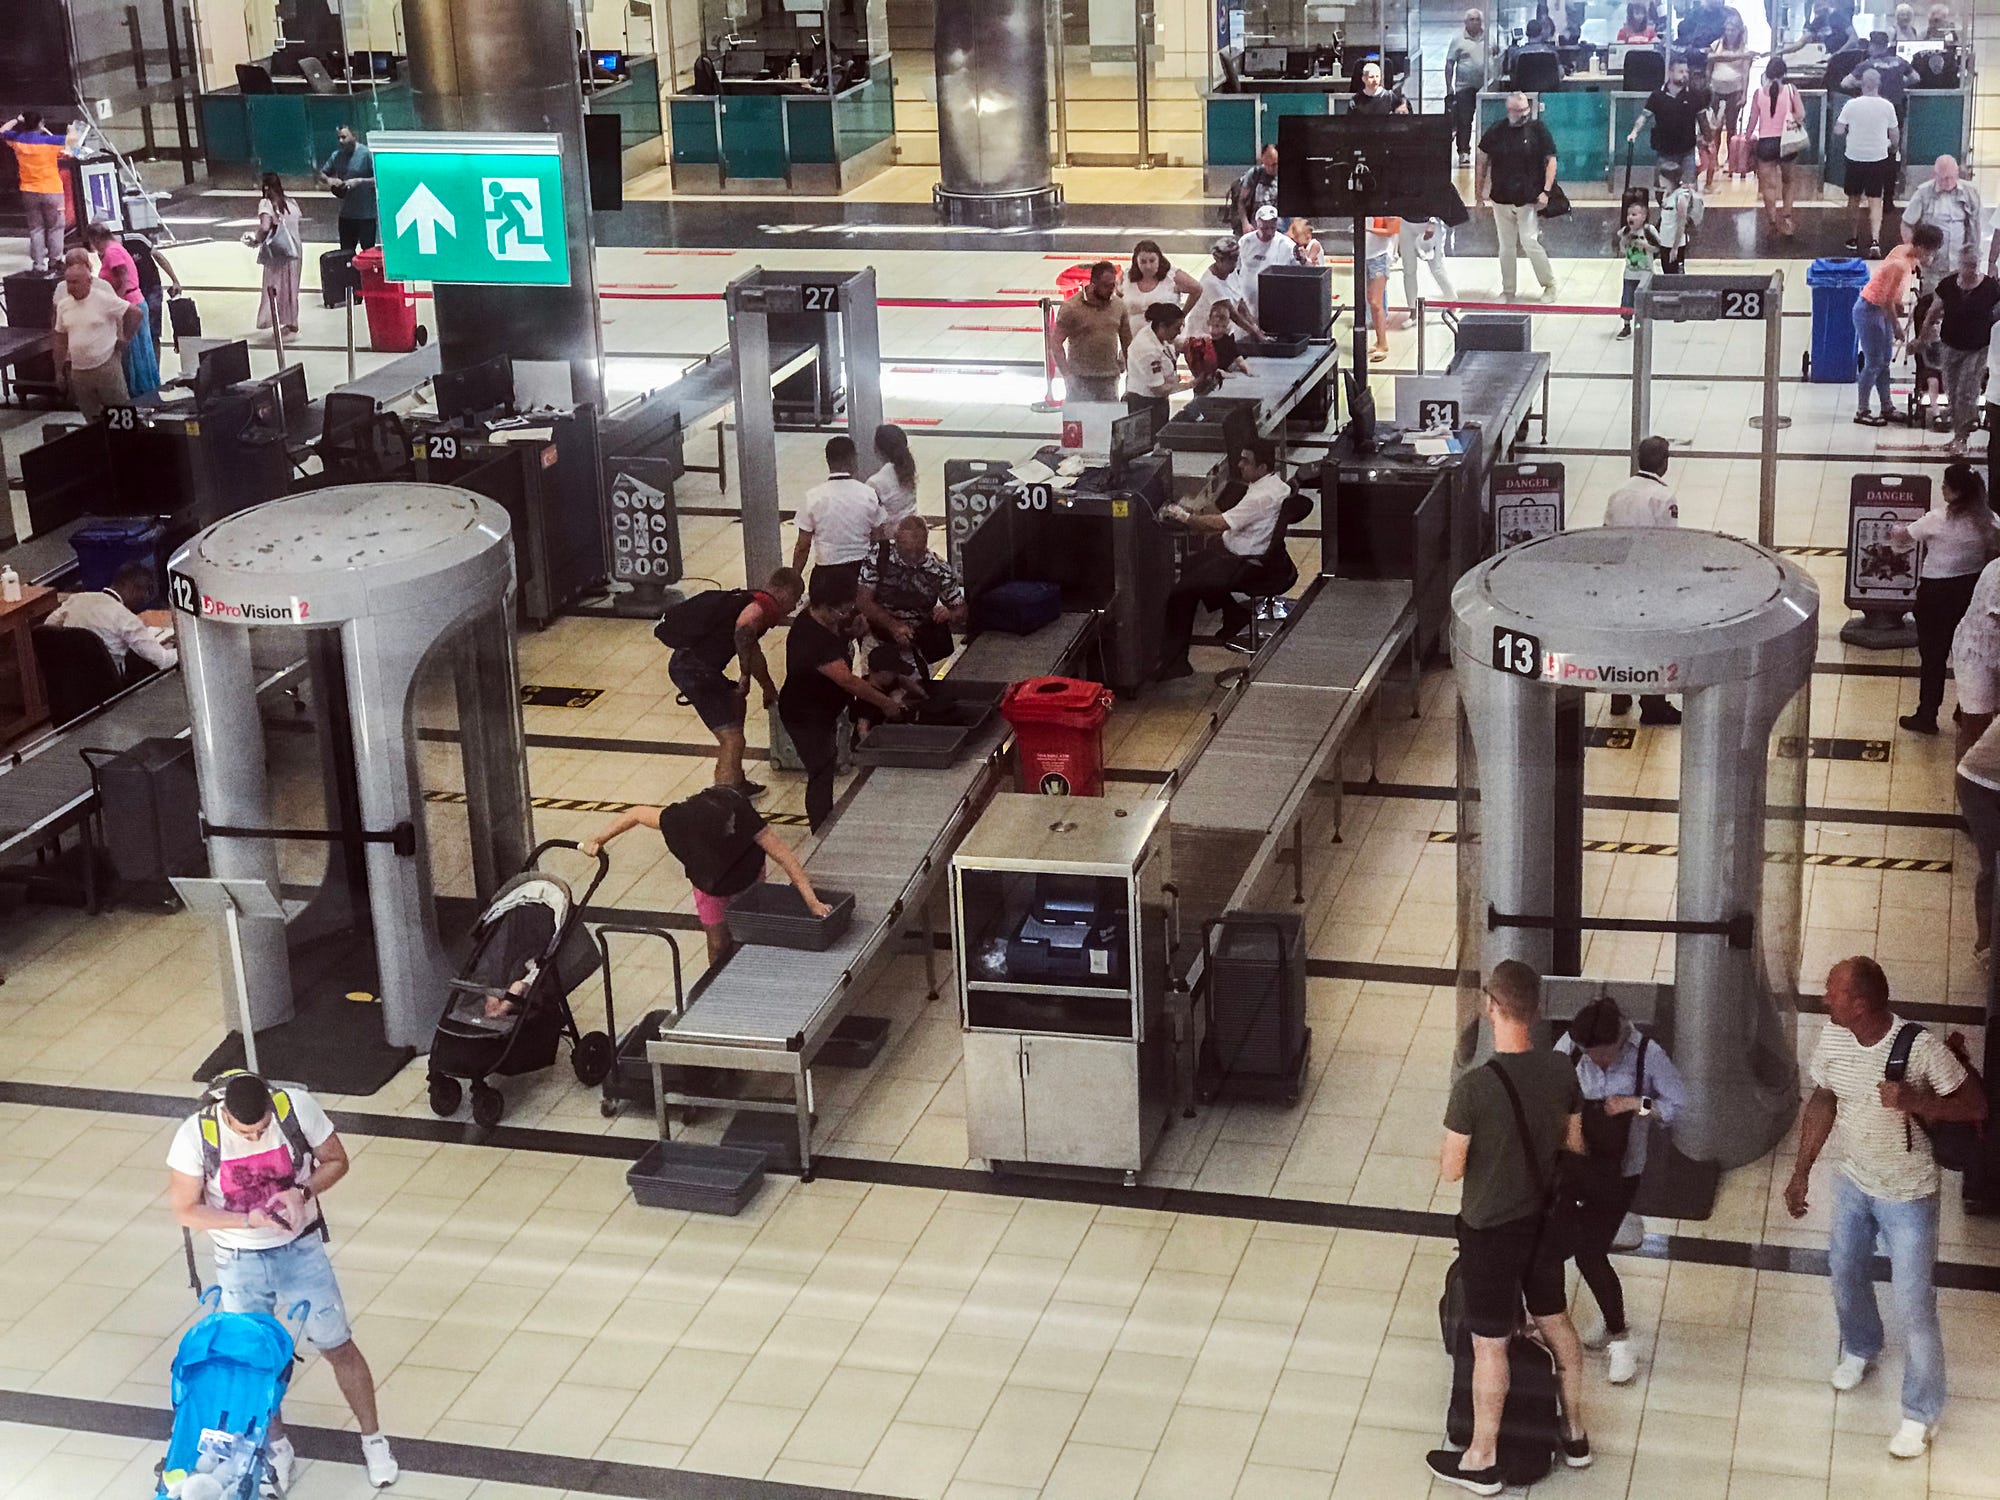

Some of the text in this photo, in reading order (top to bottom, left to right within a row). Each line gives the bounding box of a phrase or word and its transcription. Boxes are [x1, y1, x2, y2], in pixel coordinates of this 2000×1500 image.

[805, 286, 835, 310] 27
[1725, 292, 1760, 318] 28
[107, 408, 134, 430] 28
[1426, 403, 1452, 427] 31
[430, 436, 457, 459] 29
[1506, 478, 1550, 488] DANGER
[1016, 486, 1048, 510] 30
[1866, 490, 1914, 502] DANGER
[173, 575, 194, 612] 12
[216, 601, 292, 619] ProVision
[299, 601, 310, 618] 2
[1498, 633, 1534, 674] 13
[1563, 663, 1659, 683] ProVision
[1666, 663, 1679, 683] 2
